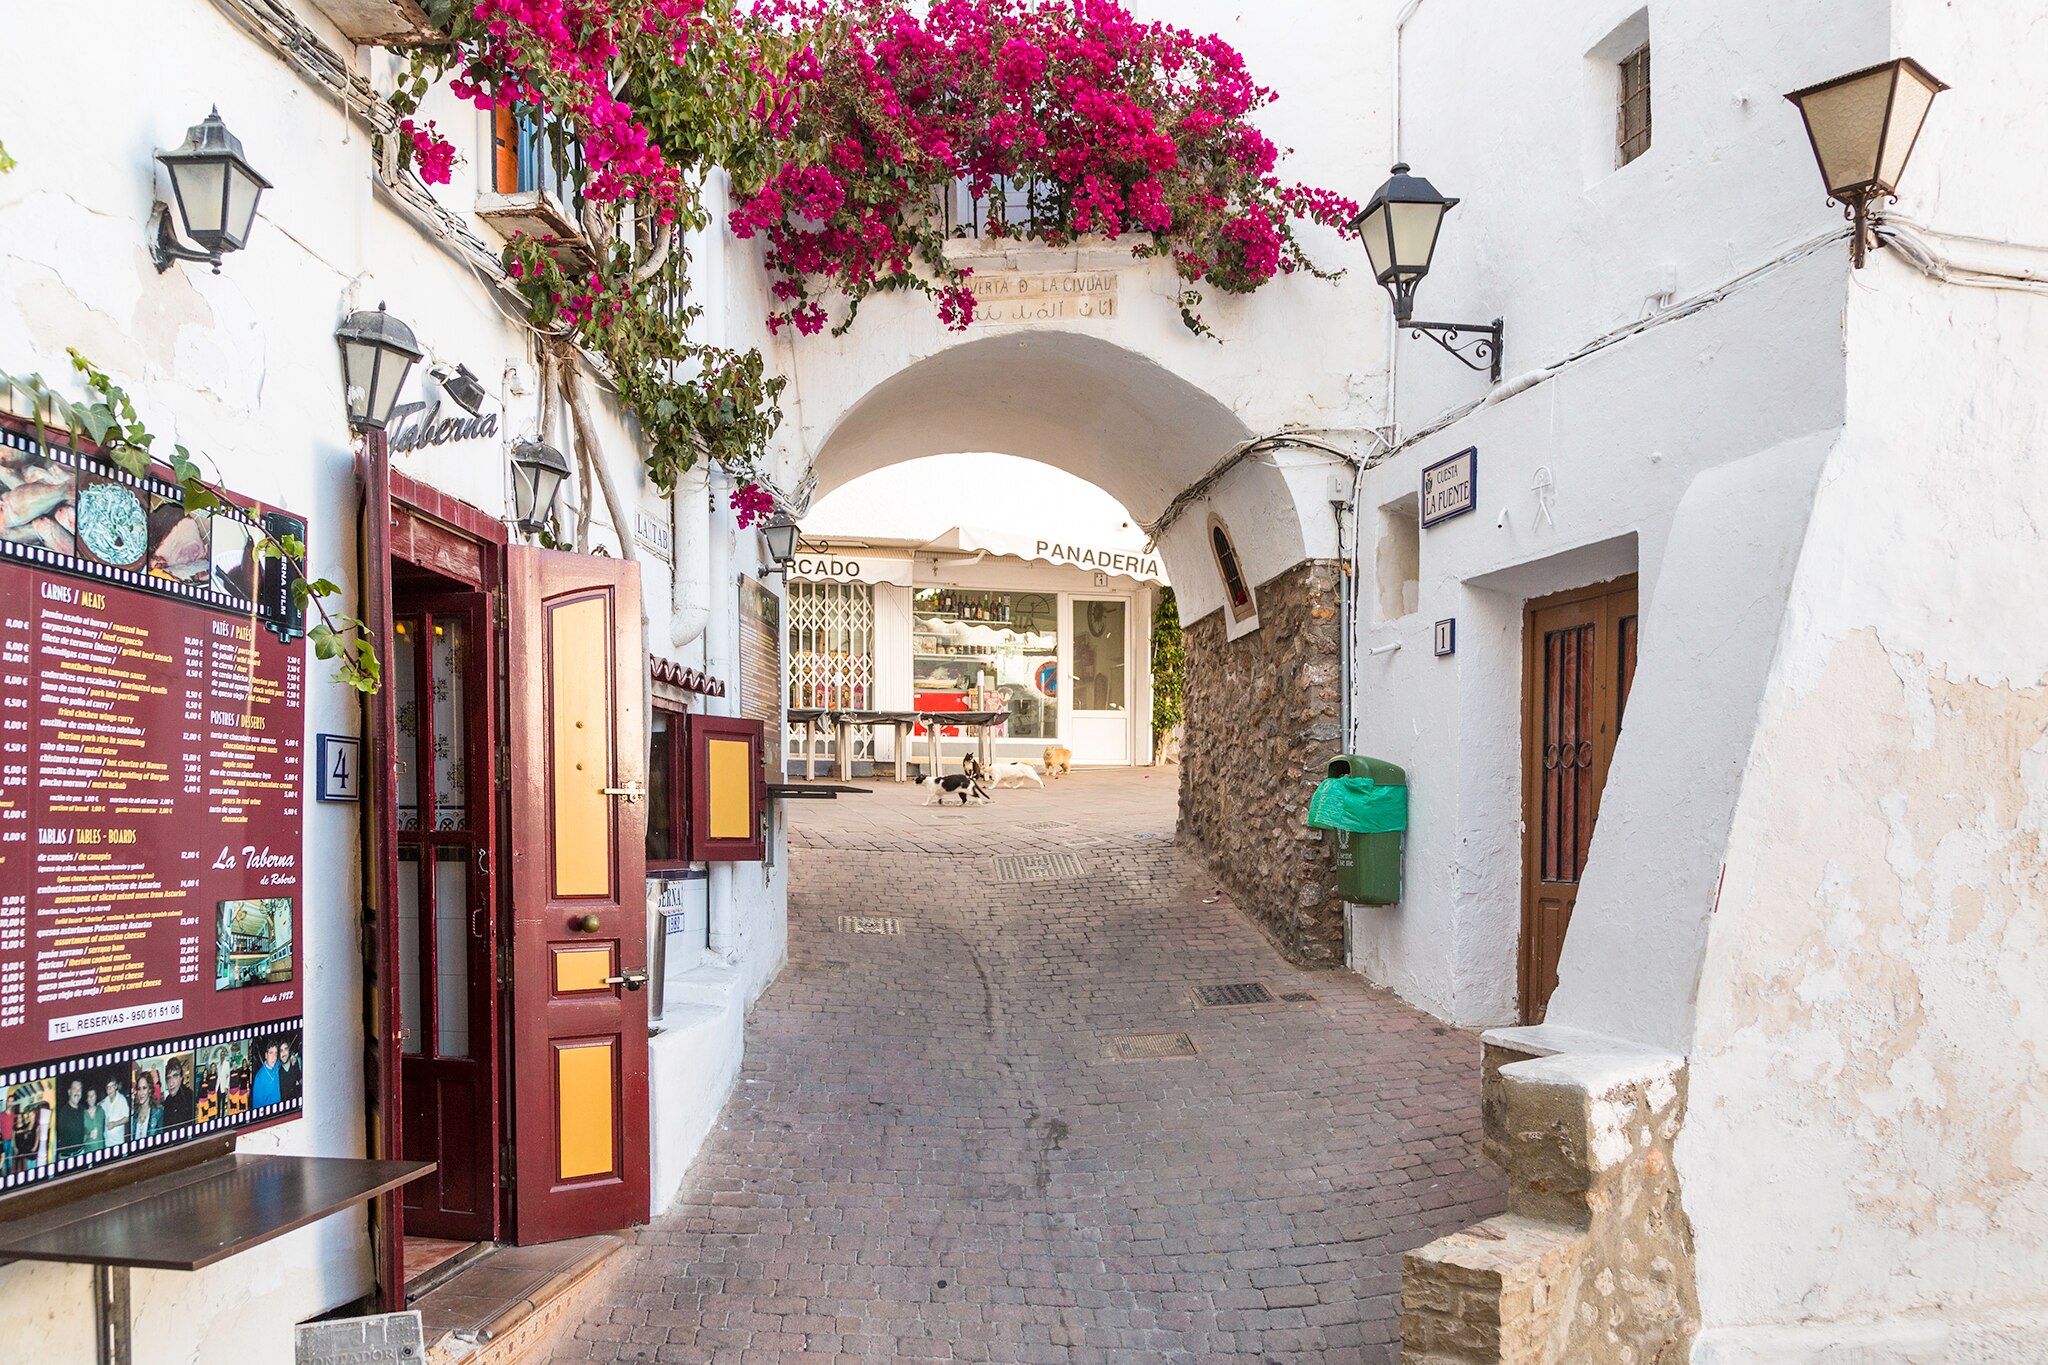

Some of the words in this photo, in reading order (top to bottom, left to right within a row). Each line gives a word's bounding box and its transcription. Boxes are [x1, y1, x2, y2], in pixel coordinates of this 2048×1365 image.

[1042, 279, 1058, 293] LA
[389, 399, 499, 458] Taberna
[1436, 464, 1458, 484] CUESTA
[1426, 495, 1436, 516] LA
[1438, 480, 1469, 511] FUENTE
[637, 513, 648, 539] LA
[652, 523, 668, 550] TAB
[785, 558, 860, 577] RCADO
[1036, 540, 1158, 577] PANADERIA
[41, 582, 71, 604] CARNES
[81, 591, 105, 610] MEATS
[73, 626, 82, 635] de
[102, 631, 116, 642] beef
[112, 623, 135, 634] roasted
[136, 627, 148, 636] ham
[212, 620, 230, 637] PATÉS
[1440, 627, 1445, 649] 1
[74, 709, 98, 719] chicken
[210, 710, 235, 727] POSTRES
[240, 715, 266, 730] DESSERTS
[56, 743, 65, 752] de
[333, 747, 350, 789] 4
[38, 828, 67, 845] TABLAS
[76, 828, 102, 845] TABLES
[108, 828, 137, 845] BOARDS
[37, 853, 47, 862] de
[78, 852, 87, 861] de
[211, 846, 237, 870] La
[241, 845, 295, 870] Taberna
[260, 875, 270, 886] de
[270, 873, 296, 886] Roberto
[278, 991, 294, 1002] 1982
[54, 1022, 75, 1034] TEL.
[77, 1013, 124, 1031] RESERVAS
[131, 1009, 146, 1021] 950
[148, 1008, 157, 1019] 61
[160, 1006, 168, 1017] 51
[170, 1004, 180, 1015] 06
